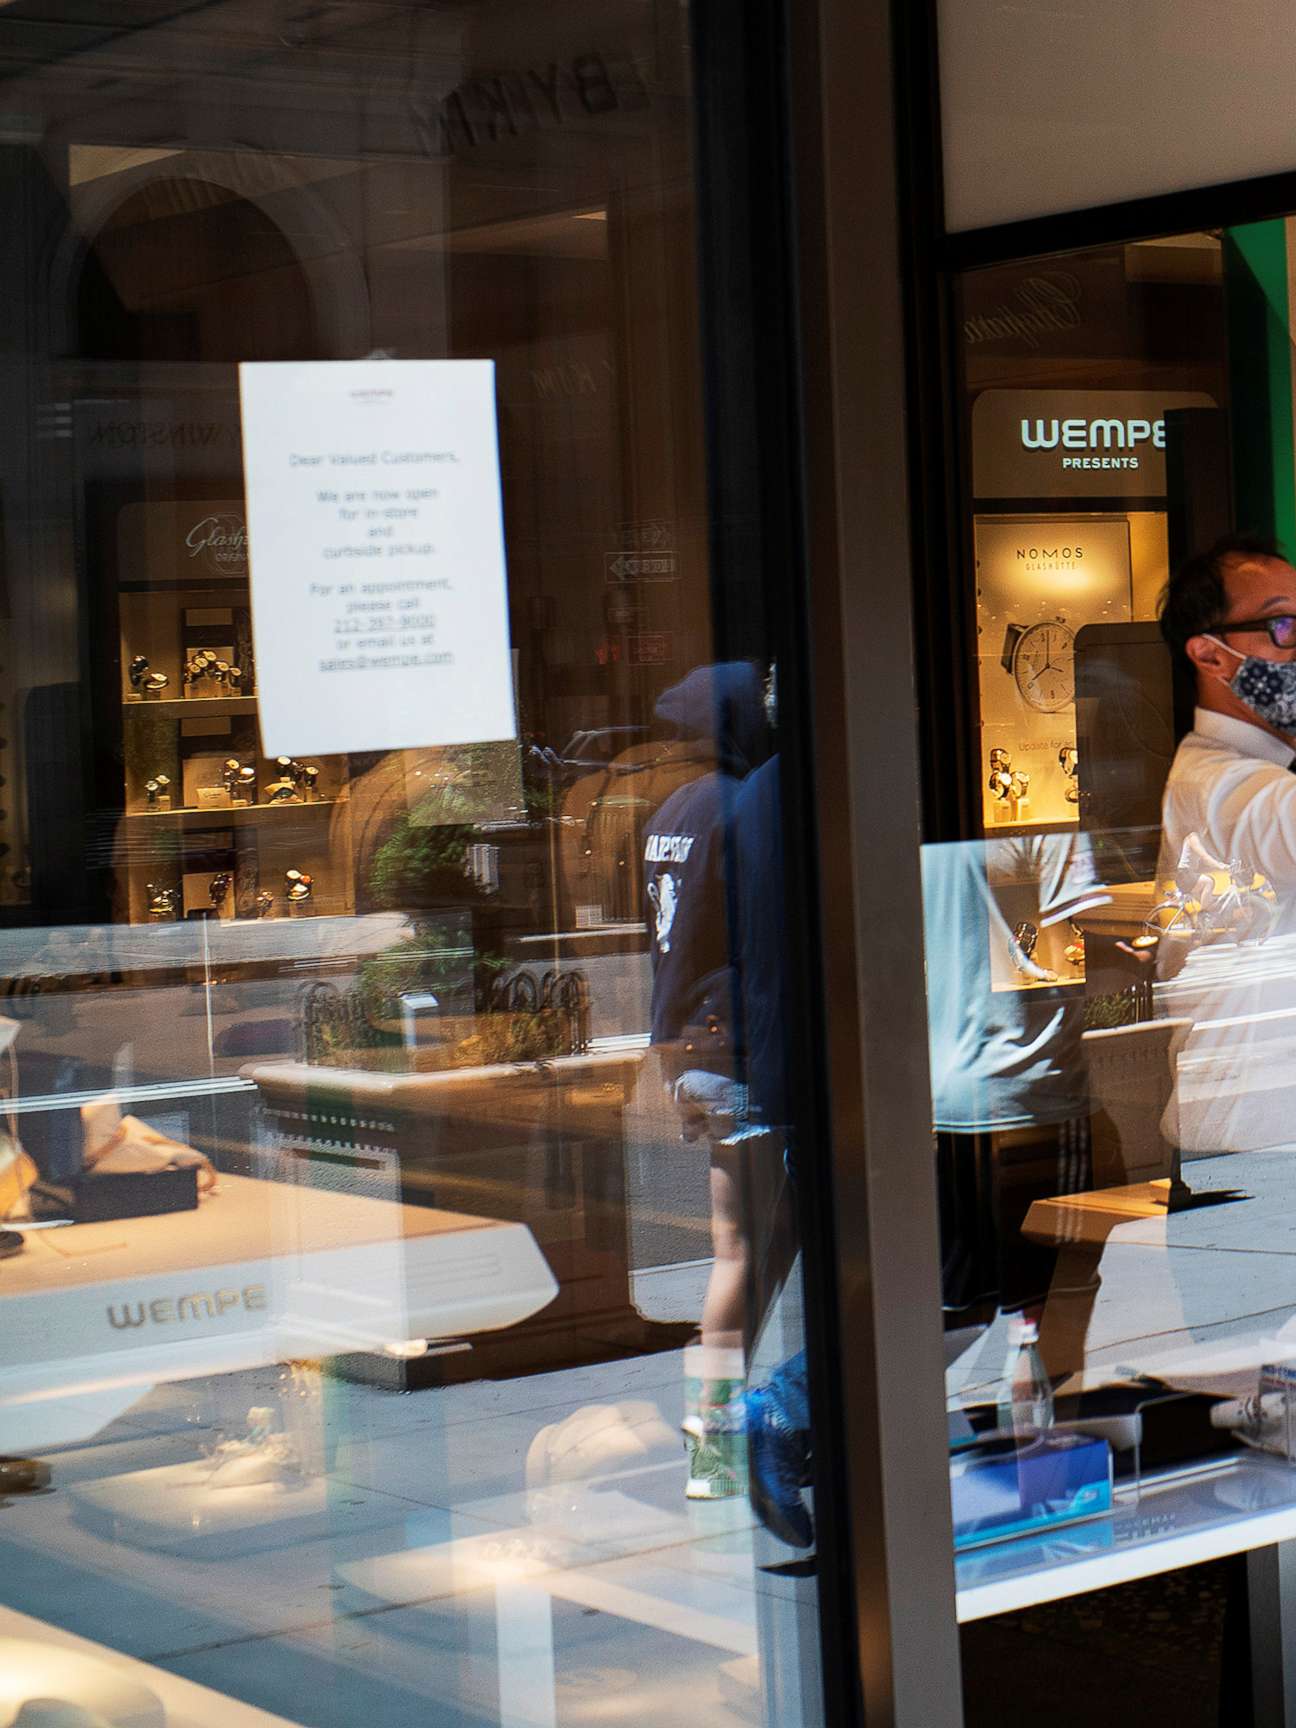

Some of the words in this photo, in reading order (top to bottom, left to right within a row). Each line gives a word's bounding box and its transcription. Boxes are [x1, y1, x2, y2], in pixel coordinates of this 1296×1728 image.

[1020, 418, 1167, 449] WEMPE
[1062, 457, 1139, 470] PRESENTS
[1016, 547, 1084, 561] NOMOS
[107, 1283, 268, 1330] WEMPE
